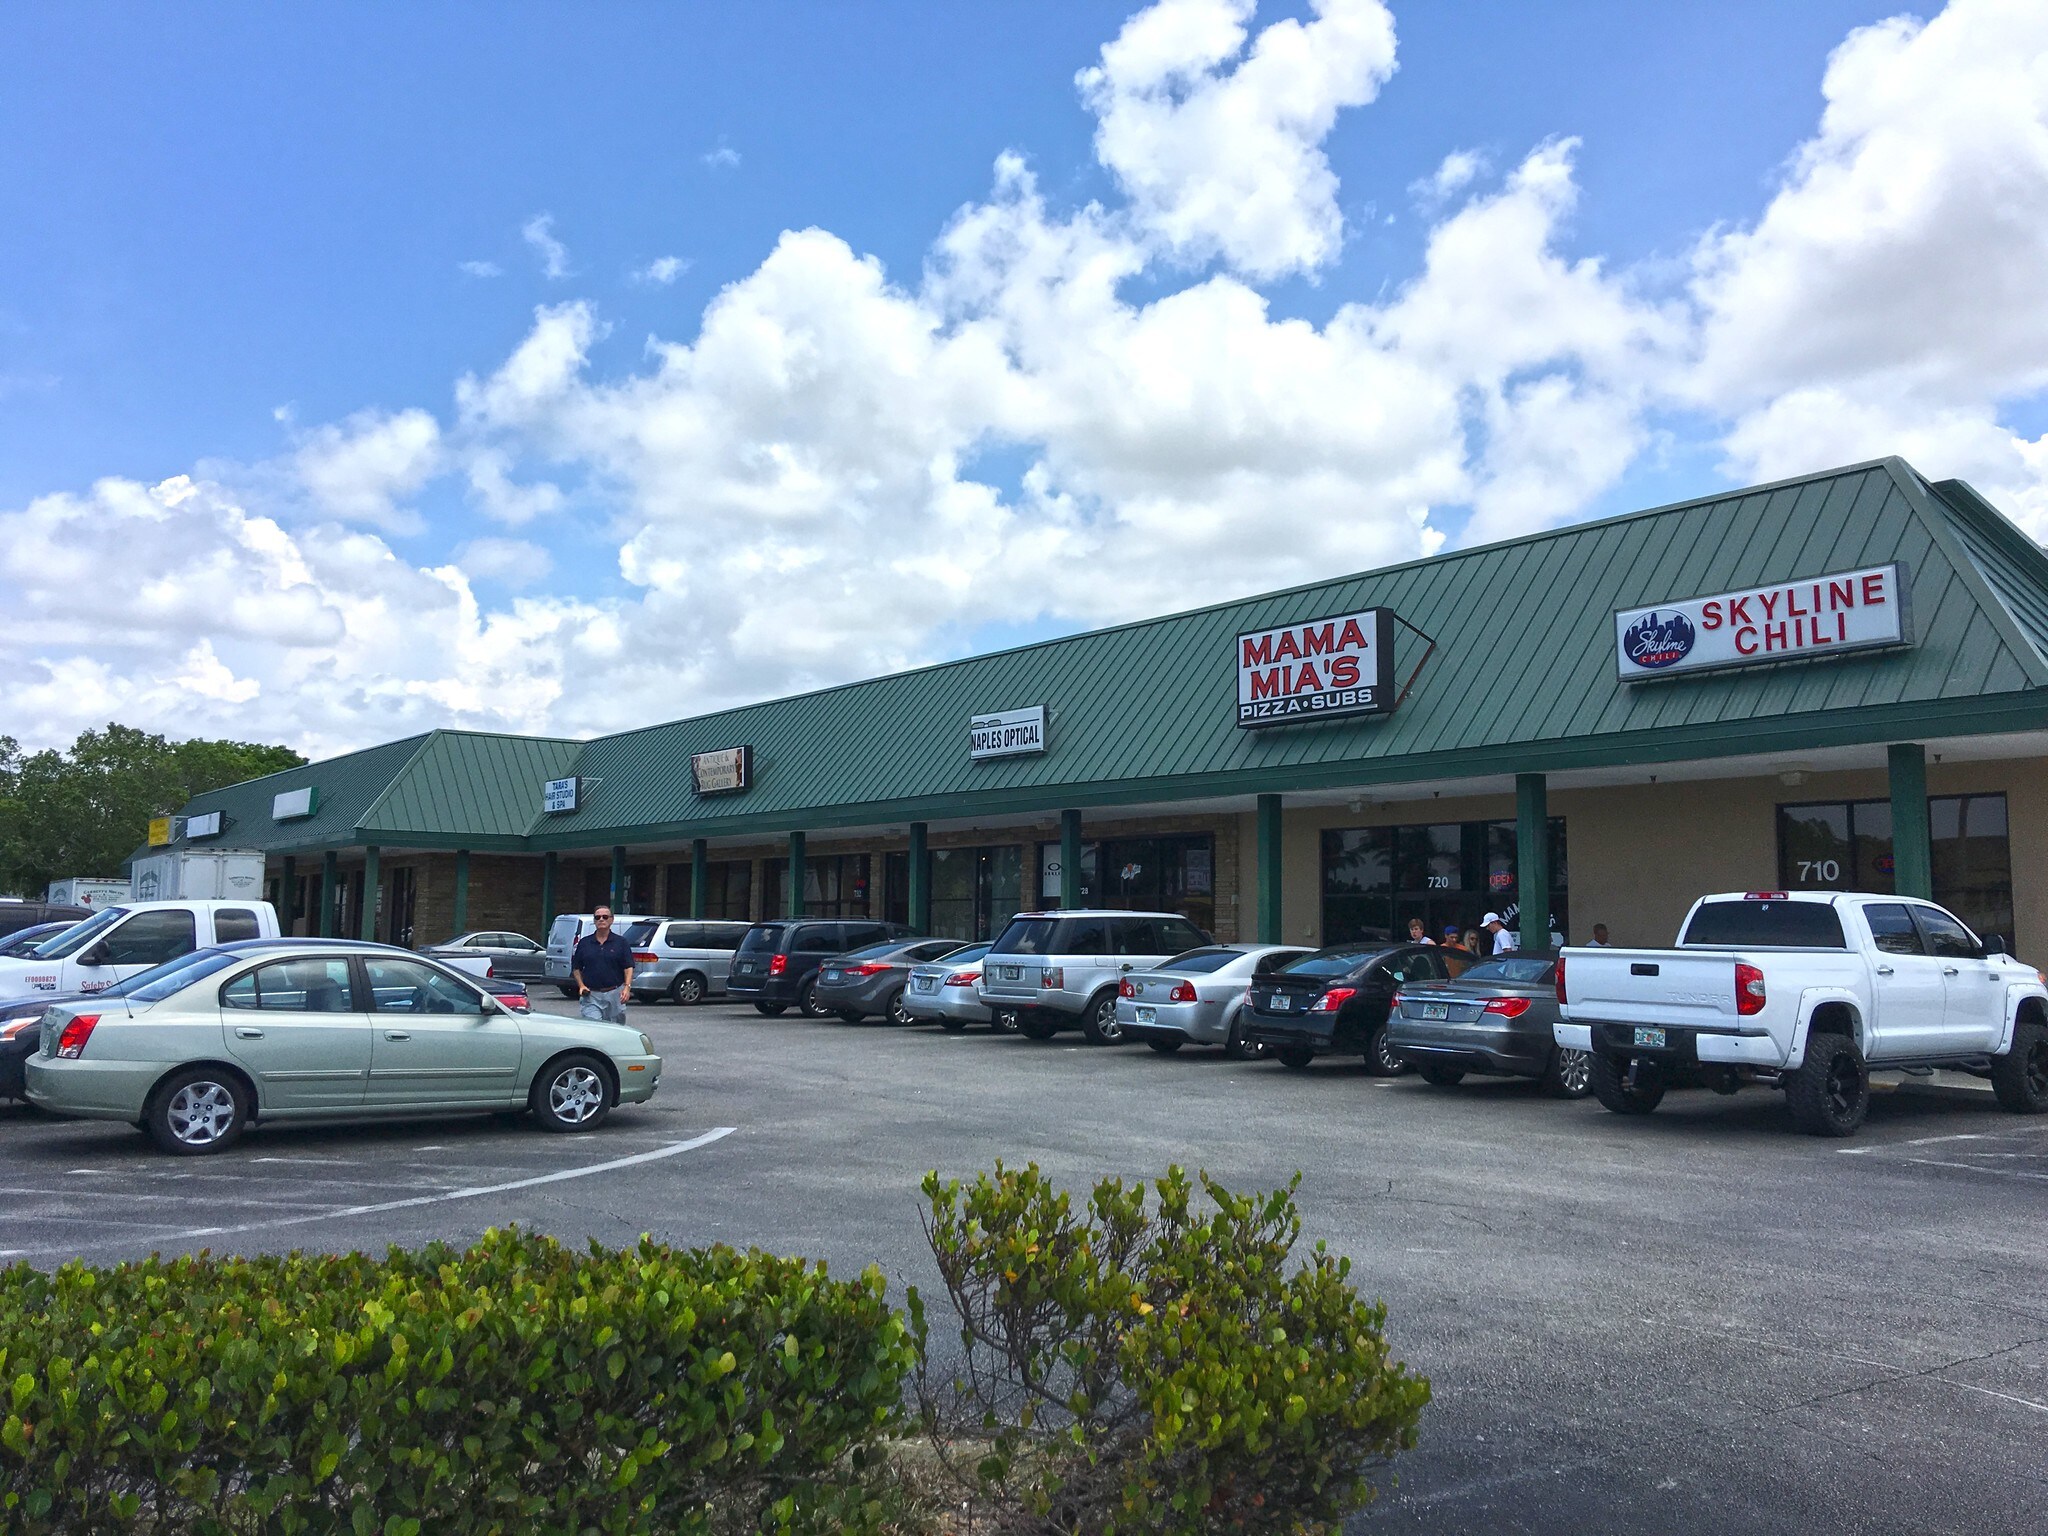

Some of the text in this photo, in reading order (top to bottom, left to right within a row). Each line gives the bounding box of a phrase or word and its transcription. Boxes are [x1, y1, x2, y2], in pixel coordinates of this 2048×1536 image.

[1702, 574, 1886, 630] SKYLINE
[1243, 618, 1369, 668] MAMA
[1632, 629, 1687, 662] Skyline
[1735, 612, 1846, 655] CHILI
[1642, 652, 1676, 663] CHILI
[1250, 655, 1361, 701] MIA'S
[1240, 688, 1373, 719] PIZZA SUBS
[971, 725, 1040, 752] NAPLES OPTICAL
[556, 789, 574, 800] STUDIO
[556, 800, 566, 809] SPA
[1427, 876, 1449, 889] 720
[1489, 873, 1514, 887] OPEN
[1797, 859, 1840, 882] 710
[1080, 887, 1089, 895] 28
